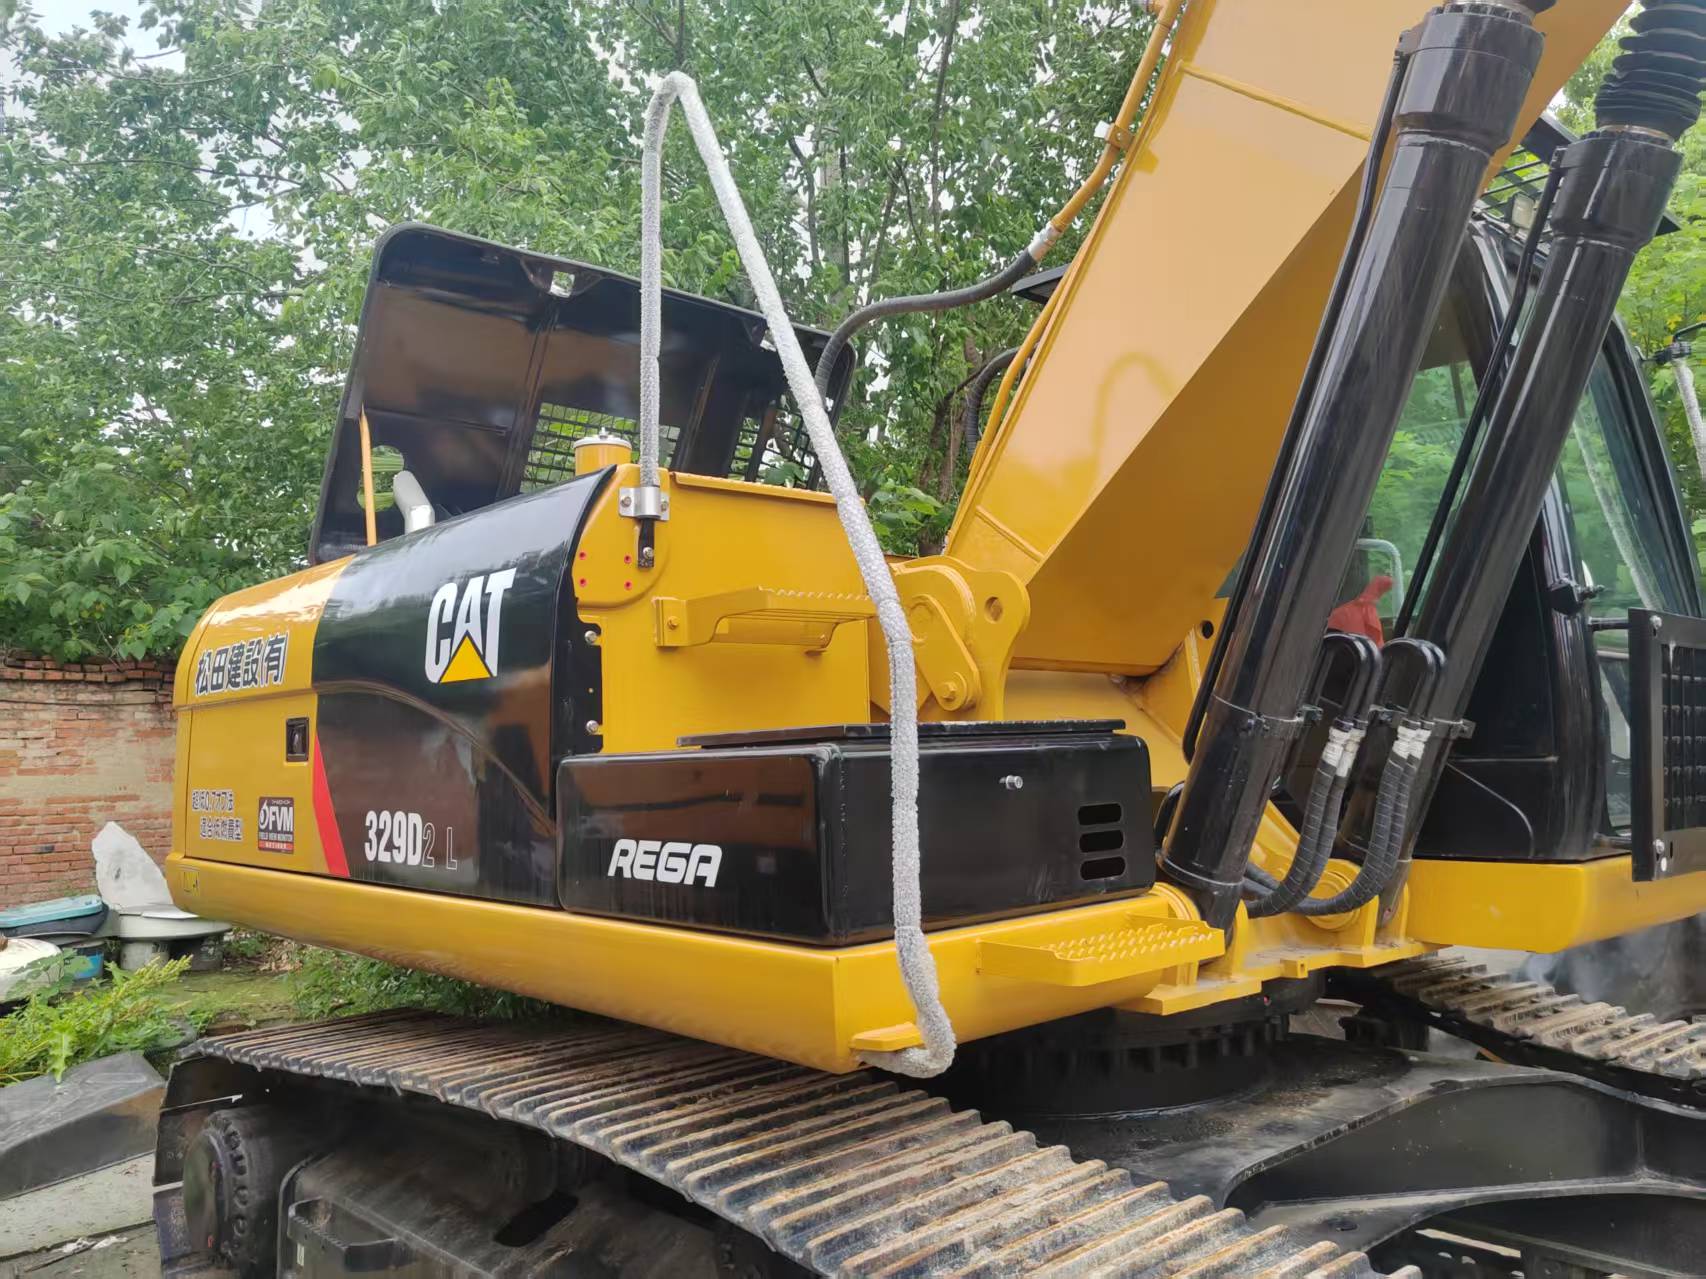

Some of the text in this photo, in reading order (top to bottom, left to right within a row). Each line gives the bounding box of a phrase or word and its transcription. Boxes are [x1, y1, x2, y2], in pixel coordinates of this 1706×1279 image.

[425, 568, 517, 684] CAT
[269, 806, 293, 832] FVM
[446, 827, 458, 871] L
[607, 838, 723, 888] REGA
